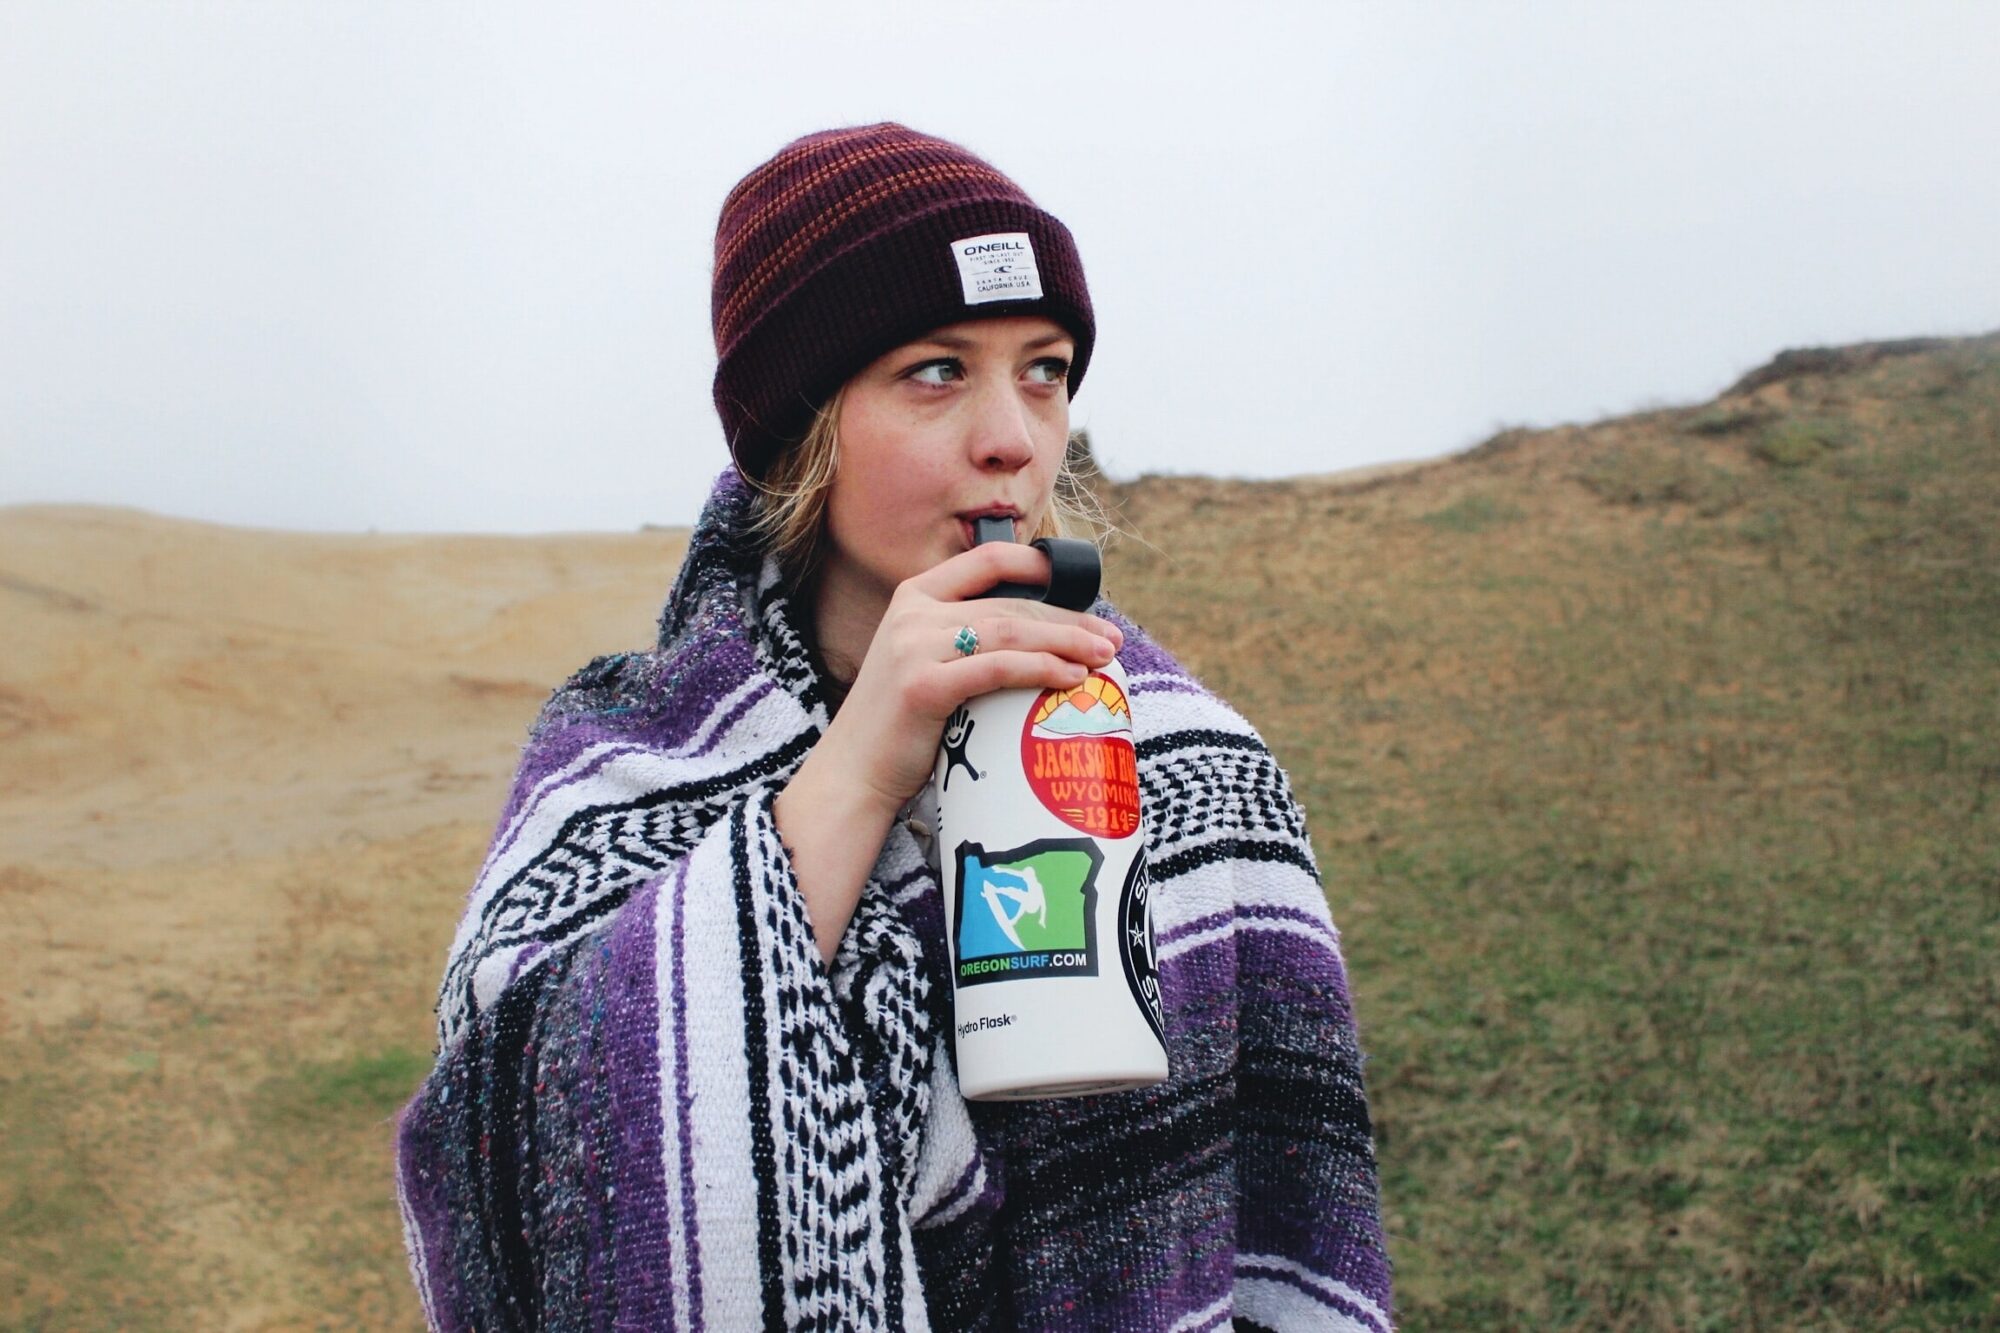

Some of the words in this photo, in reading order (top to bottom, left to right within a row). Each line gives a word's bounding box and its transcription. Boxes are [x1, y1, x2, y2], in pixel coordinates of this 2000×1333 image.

[977, 282, 1014, 292] CALIFORNIA
[1033, 741, 1117, 780] JACKSON
[1084, 806, 1129, 832] 1914
[959, 953, 1088, 978] OREGONSURF.COM
[957, 1020, 979, 1039] Hydro
